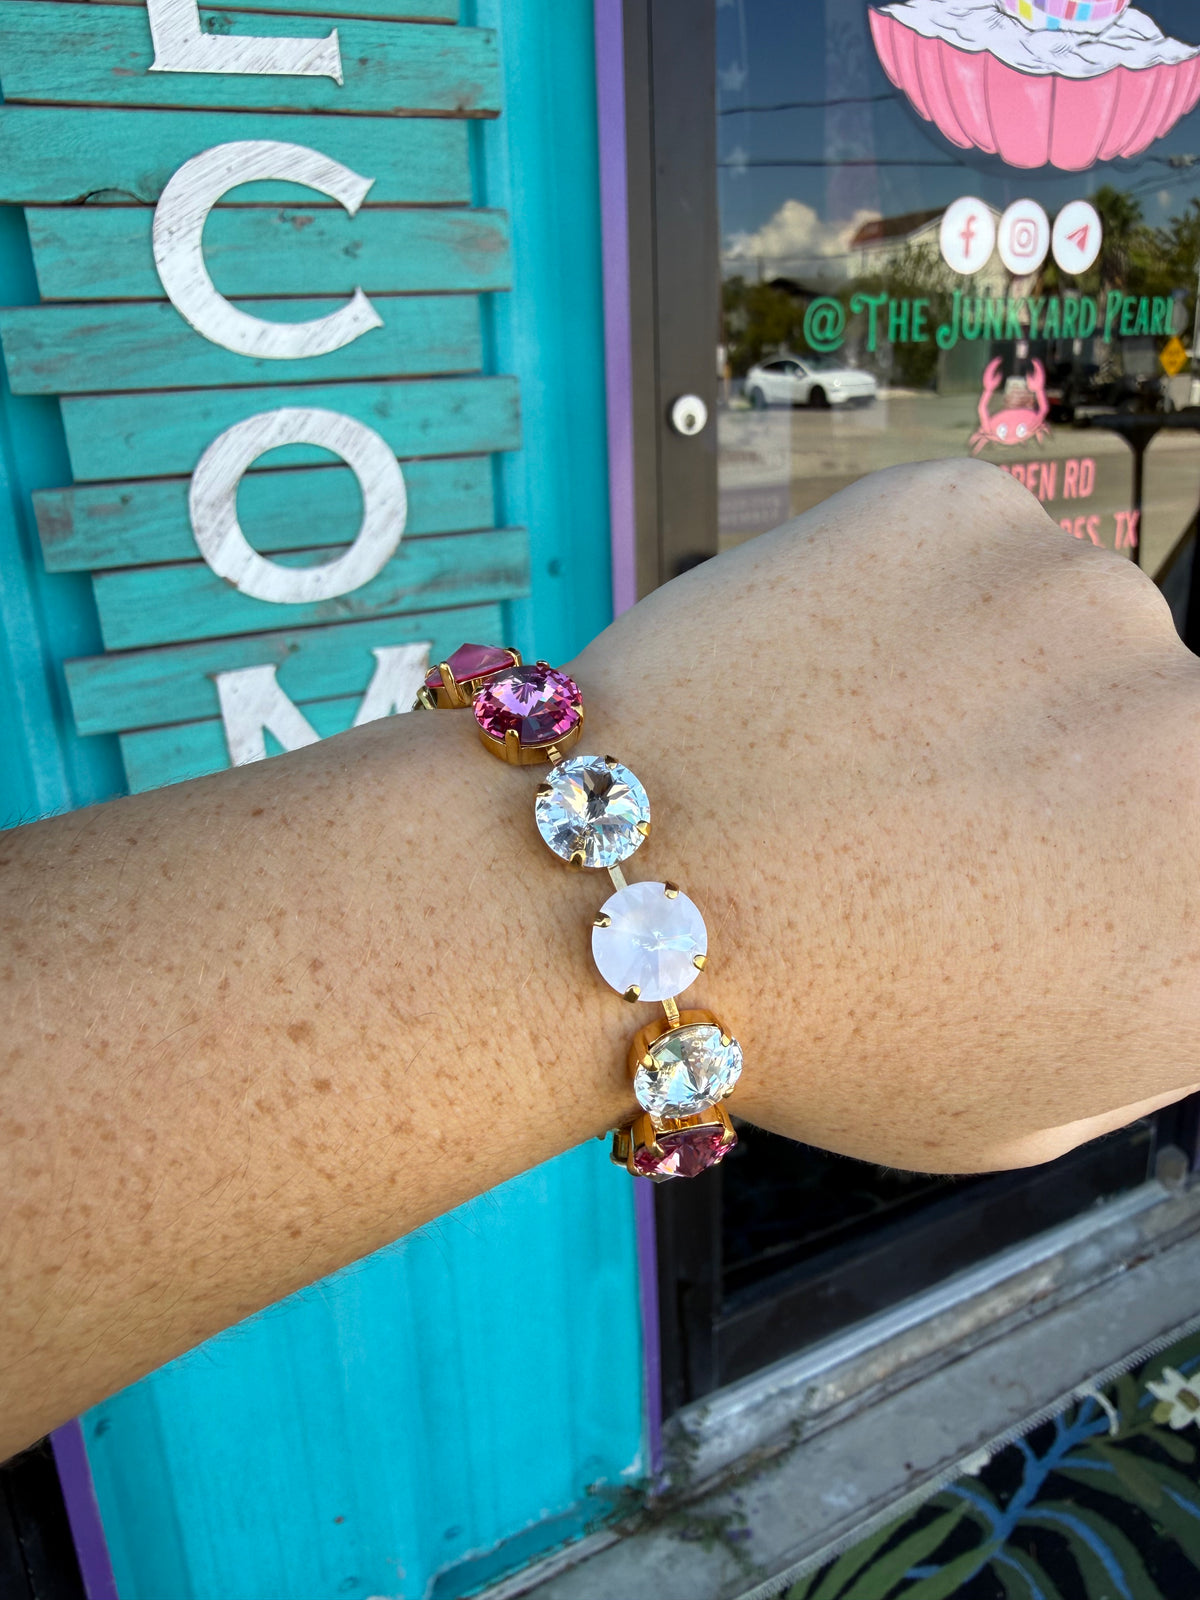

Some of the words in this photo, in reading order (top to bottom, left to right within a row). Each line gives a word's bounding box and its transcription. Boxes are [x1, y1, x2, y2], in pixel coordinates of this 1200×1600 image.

[936, 289, 1097, 350] JUNKYARD
[1103, 289, 1175, 343] PEARL
[1063, 458, 1096, 499] RD
[1113, 510, 1140, 550] TX
